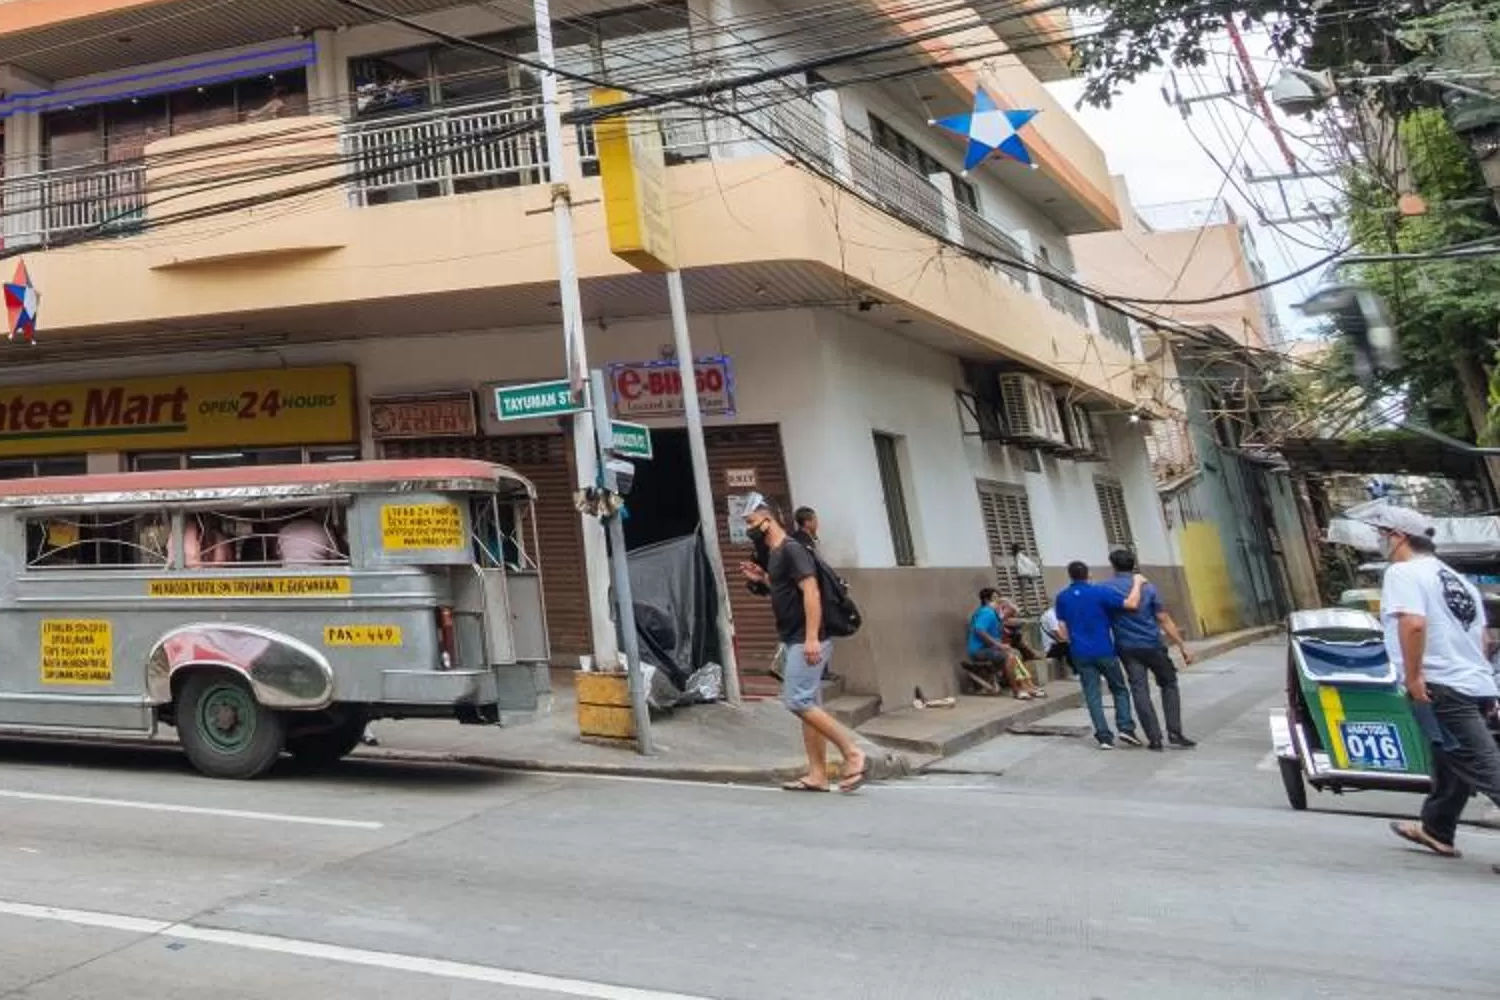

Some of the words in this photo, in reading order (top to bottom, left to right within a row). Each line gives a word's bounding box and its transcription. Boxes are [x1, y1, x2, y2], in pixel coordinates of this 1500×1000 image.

[83, 385, 189, 427] Mart
[198, 398, 239, 417] OPEN
[238, 387, 282, 419] 24
[282, 393, 338, 409] HOURS
[503, 391, 557, 412] TAYUMAN
[1347, 734, 1399, 760] 016
